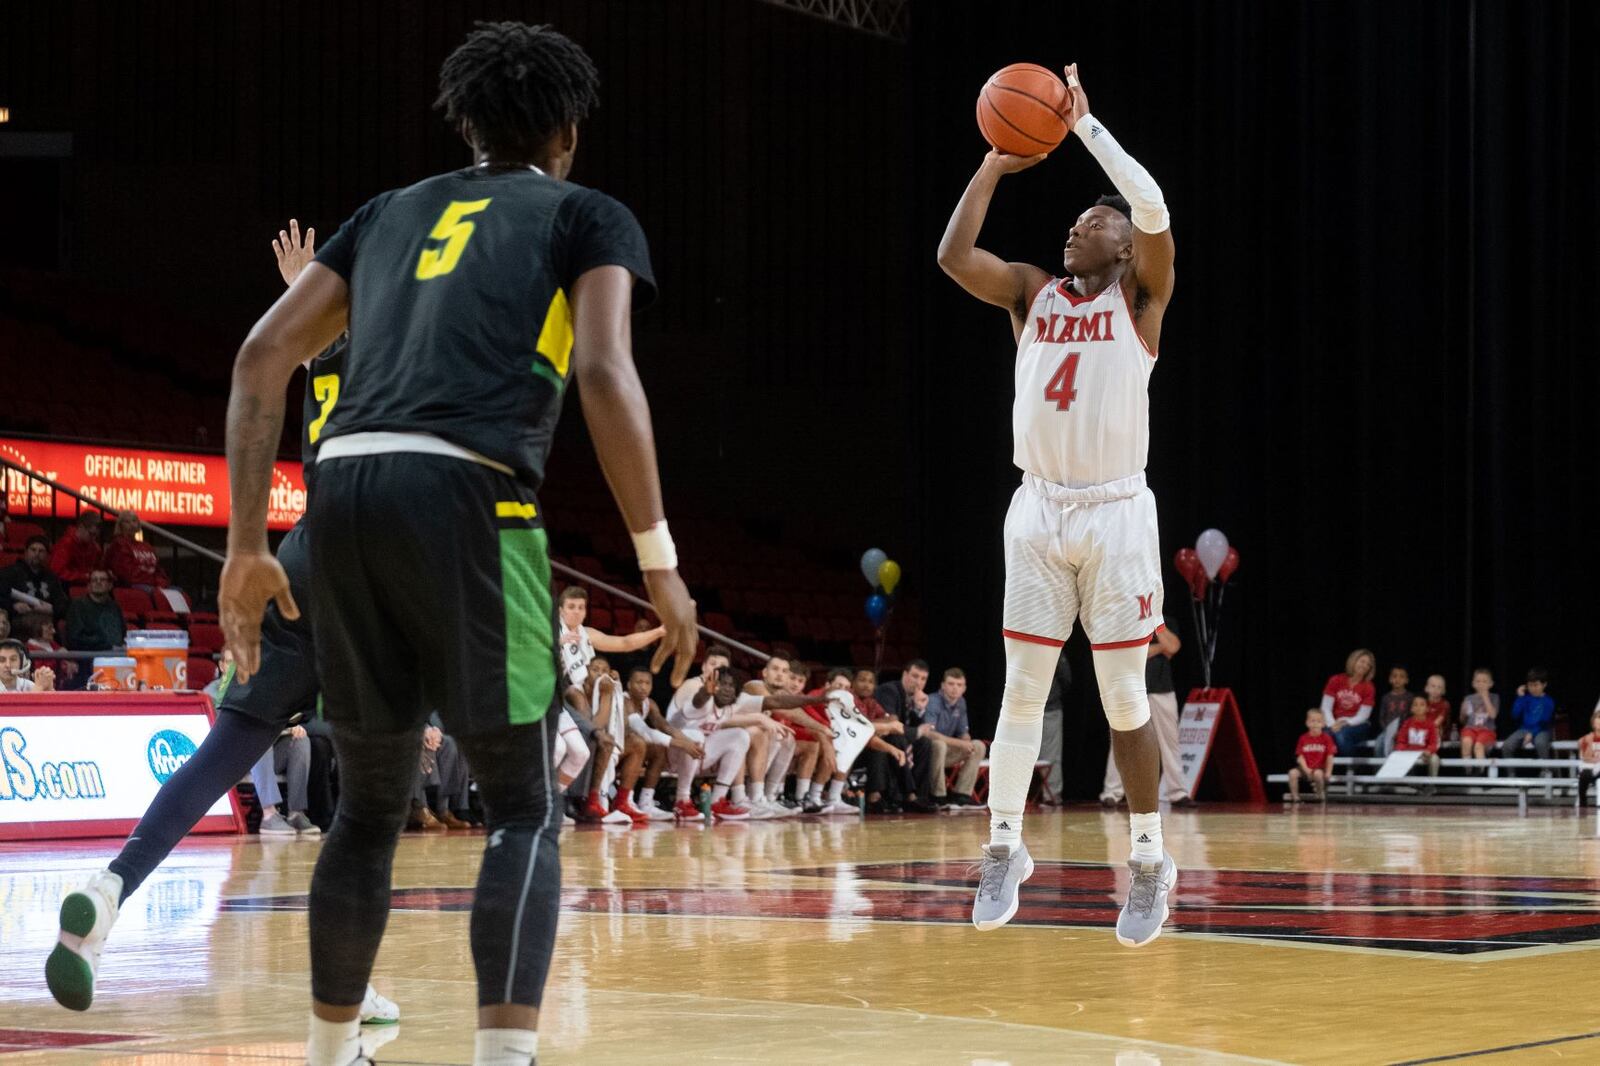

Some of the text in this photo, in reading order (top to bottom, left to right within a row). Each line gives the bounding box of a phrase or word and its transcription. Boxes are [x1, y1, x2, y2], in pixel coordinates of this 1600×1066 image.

[415, 197, 493, 280] 5
[1044, 351, 1081, 412] 4
[85, 454, 206, 485] OFFICIAL PARTNER
[101, 487, 142, 512] MIAMI
[144, 489, 214, 516] ATHLETICS
[1134, 591, 1154, 621] M
[1407, 727, 1430, 746] M
